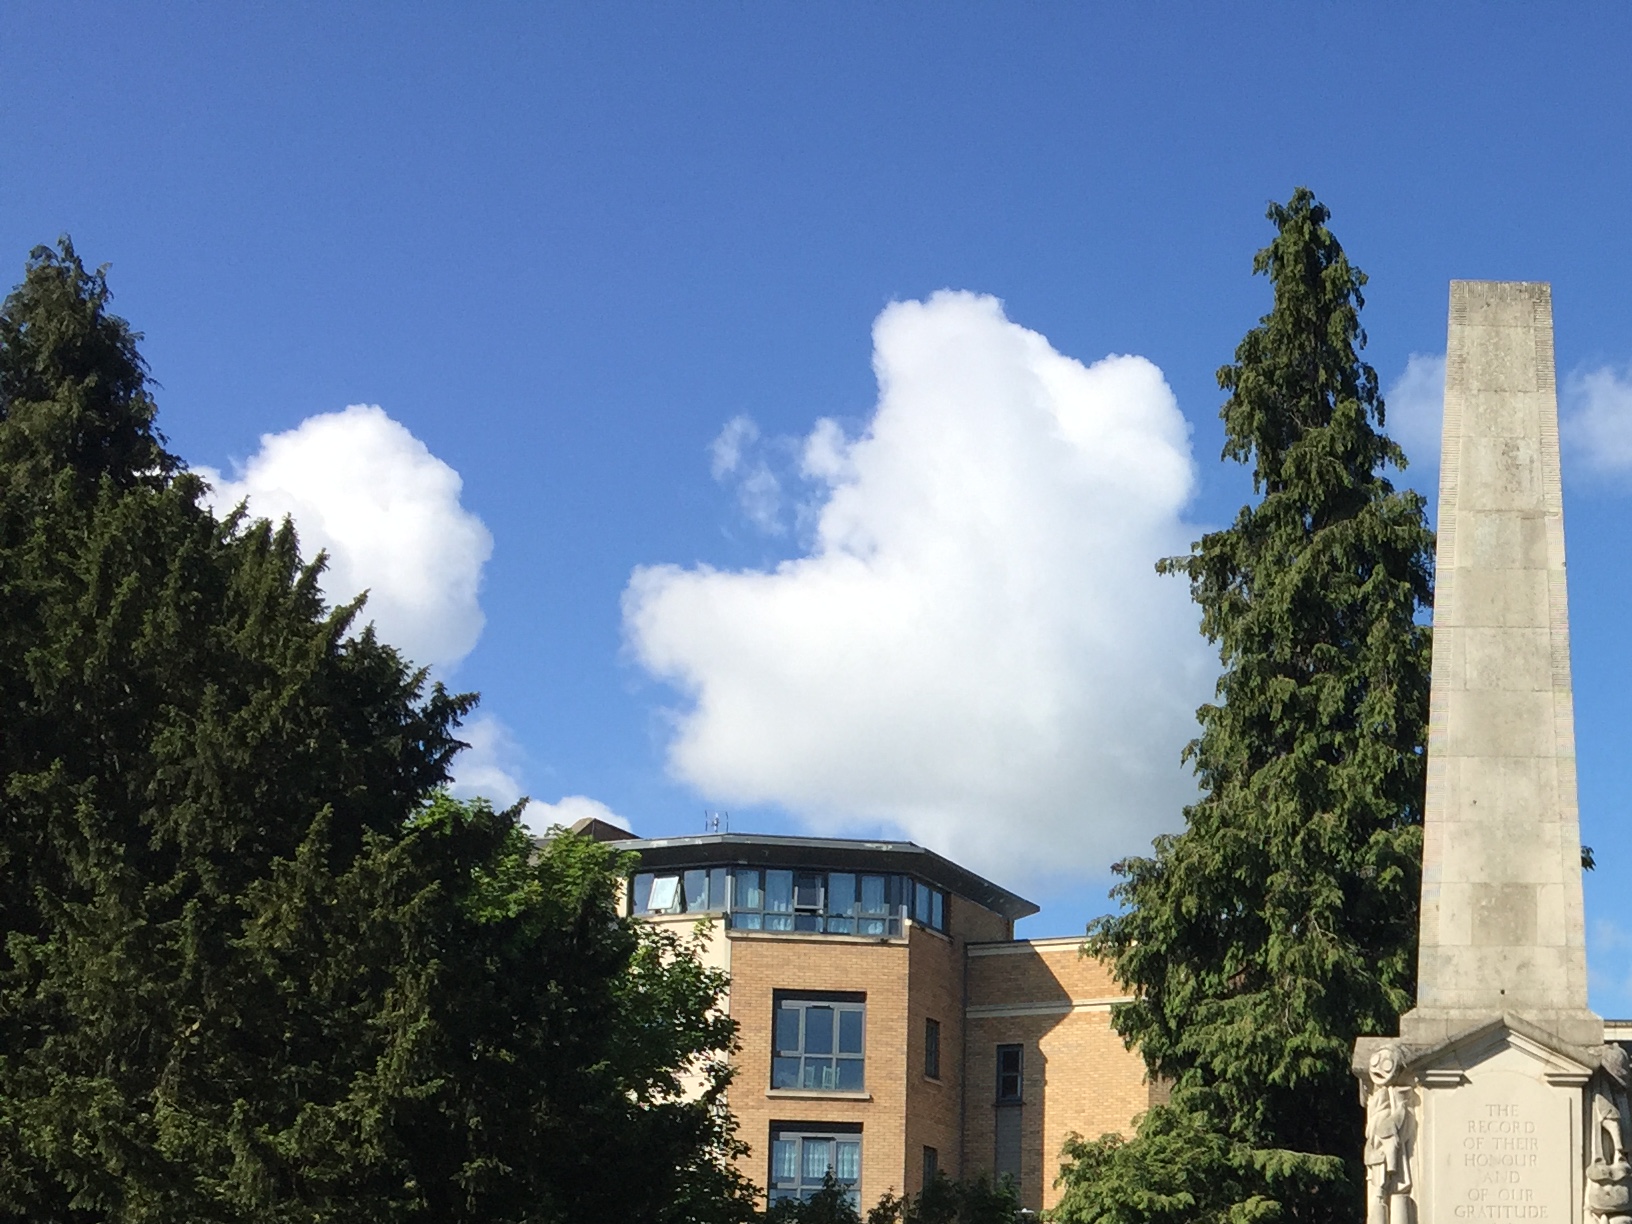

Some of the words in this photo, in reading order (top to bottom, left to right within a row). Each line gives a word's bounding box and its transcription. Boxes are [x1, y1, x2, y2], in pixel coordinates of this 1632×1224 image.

[1485, 1104, 1519, 1117] THE
[1467, 1120, 1536, 1134] RECORD
[1463, 1137, 1484, 1150] OF
[1492, 1137, 1539, 1150] THEIR
[1464, 1153, 1538, 1167] HONOUR
[1482, 1170, 1521, 1184] AND
[1467, 1188, 1488, 1201] OF
[1498, 1188, 1534, 1201] OUR
[1454, 1204, 1548, 1218] GRATITUDE
